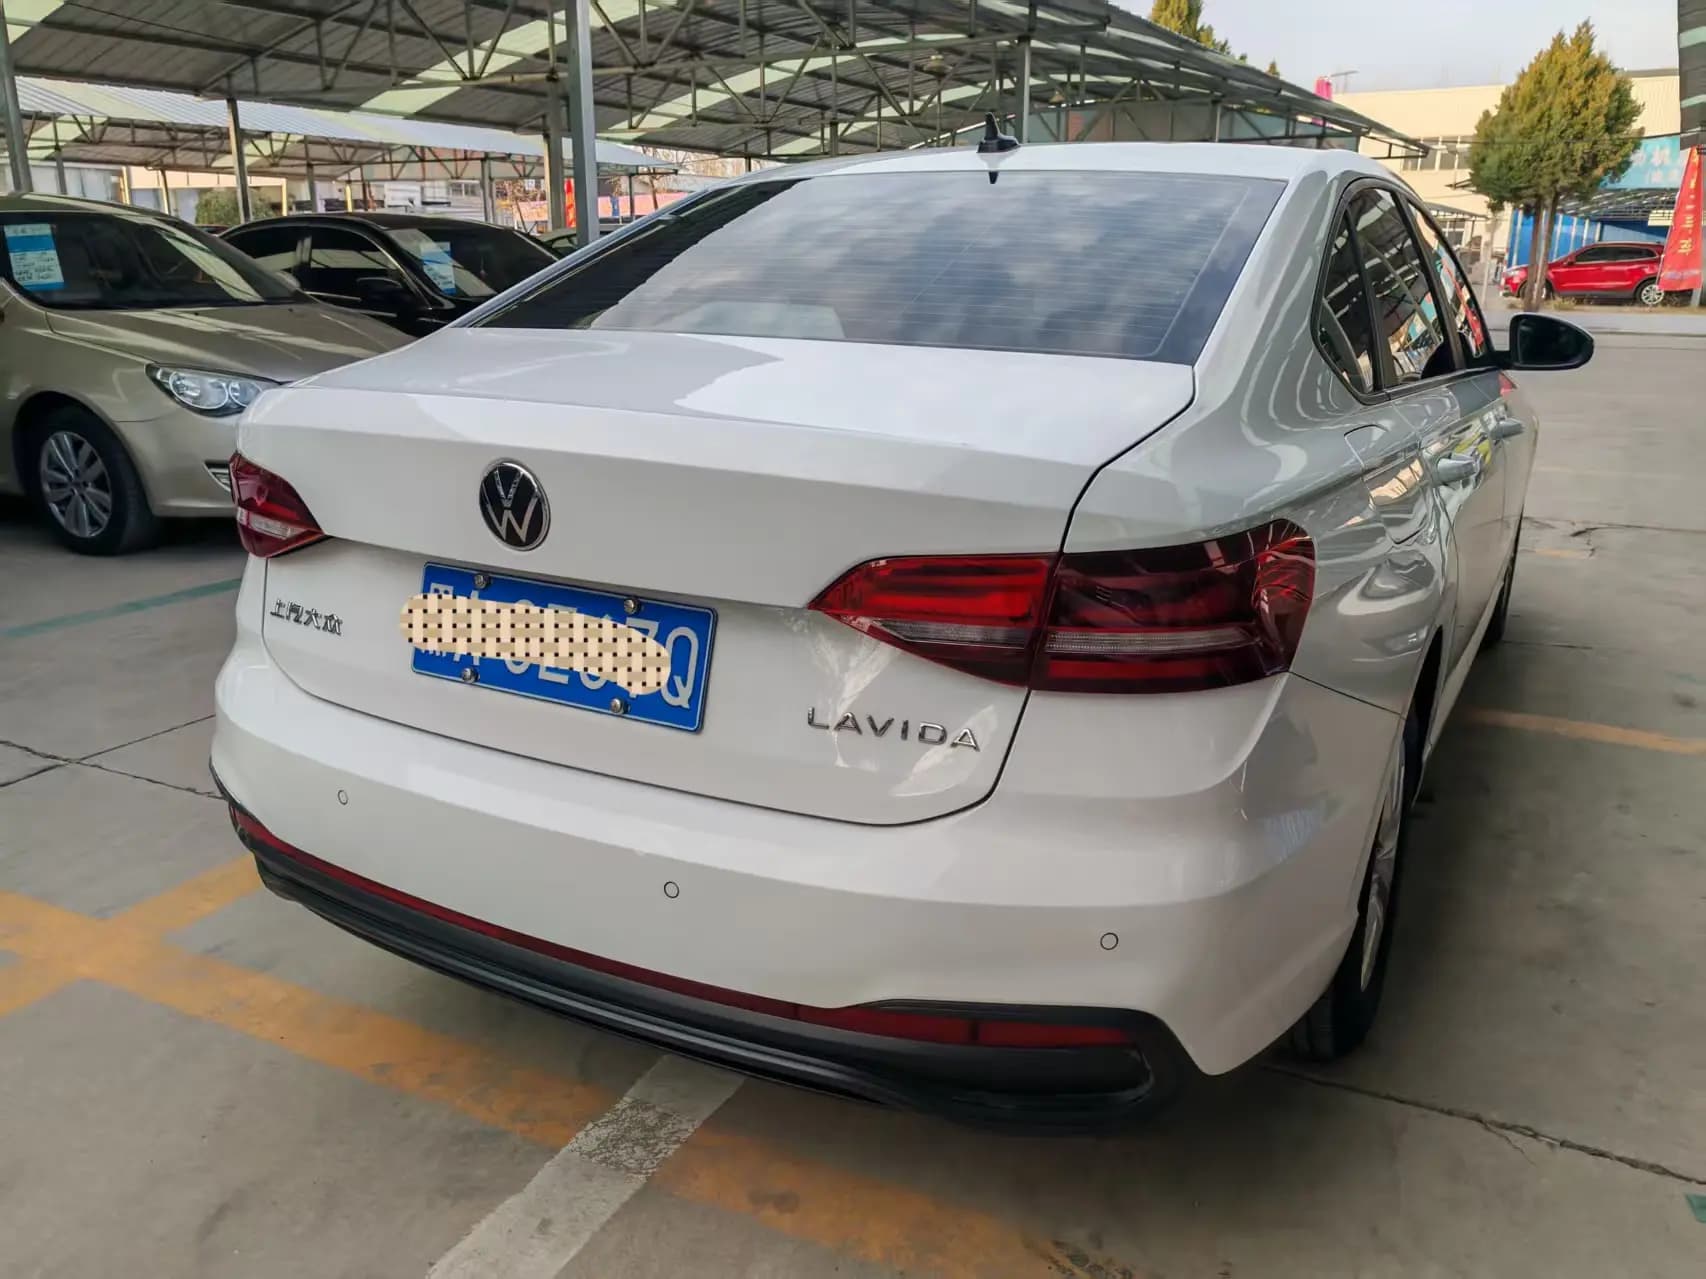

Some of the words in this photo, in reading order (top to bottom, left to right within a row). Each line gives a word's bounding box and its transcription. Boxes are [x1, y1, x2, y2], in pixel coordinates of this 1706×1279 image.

[481, 463, 545, 546] VW
[270, 599, 342, 636] 上汽大众
[807, 707, 980, 752] LAVIDA
